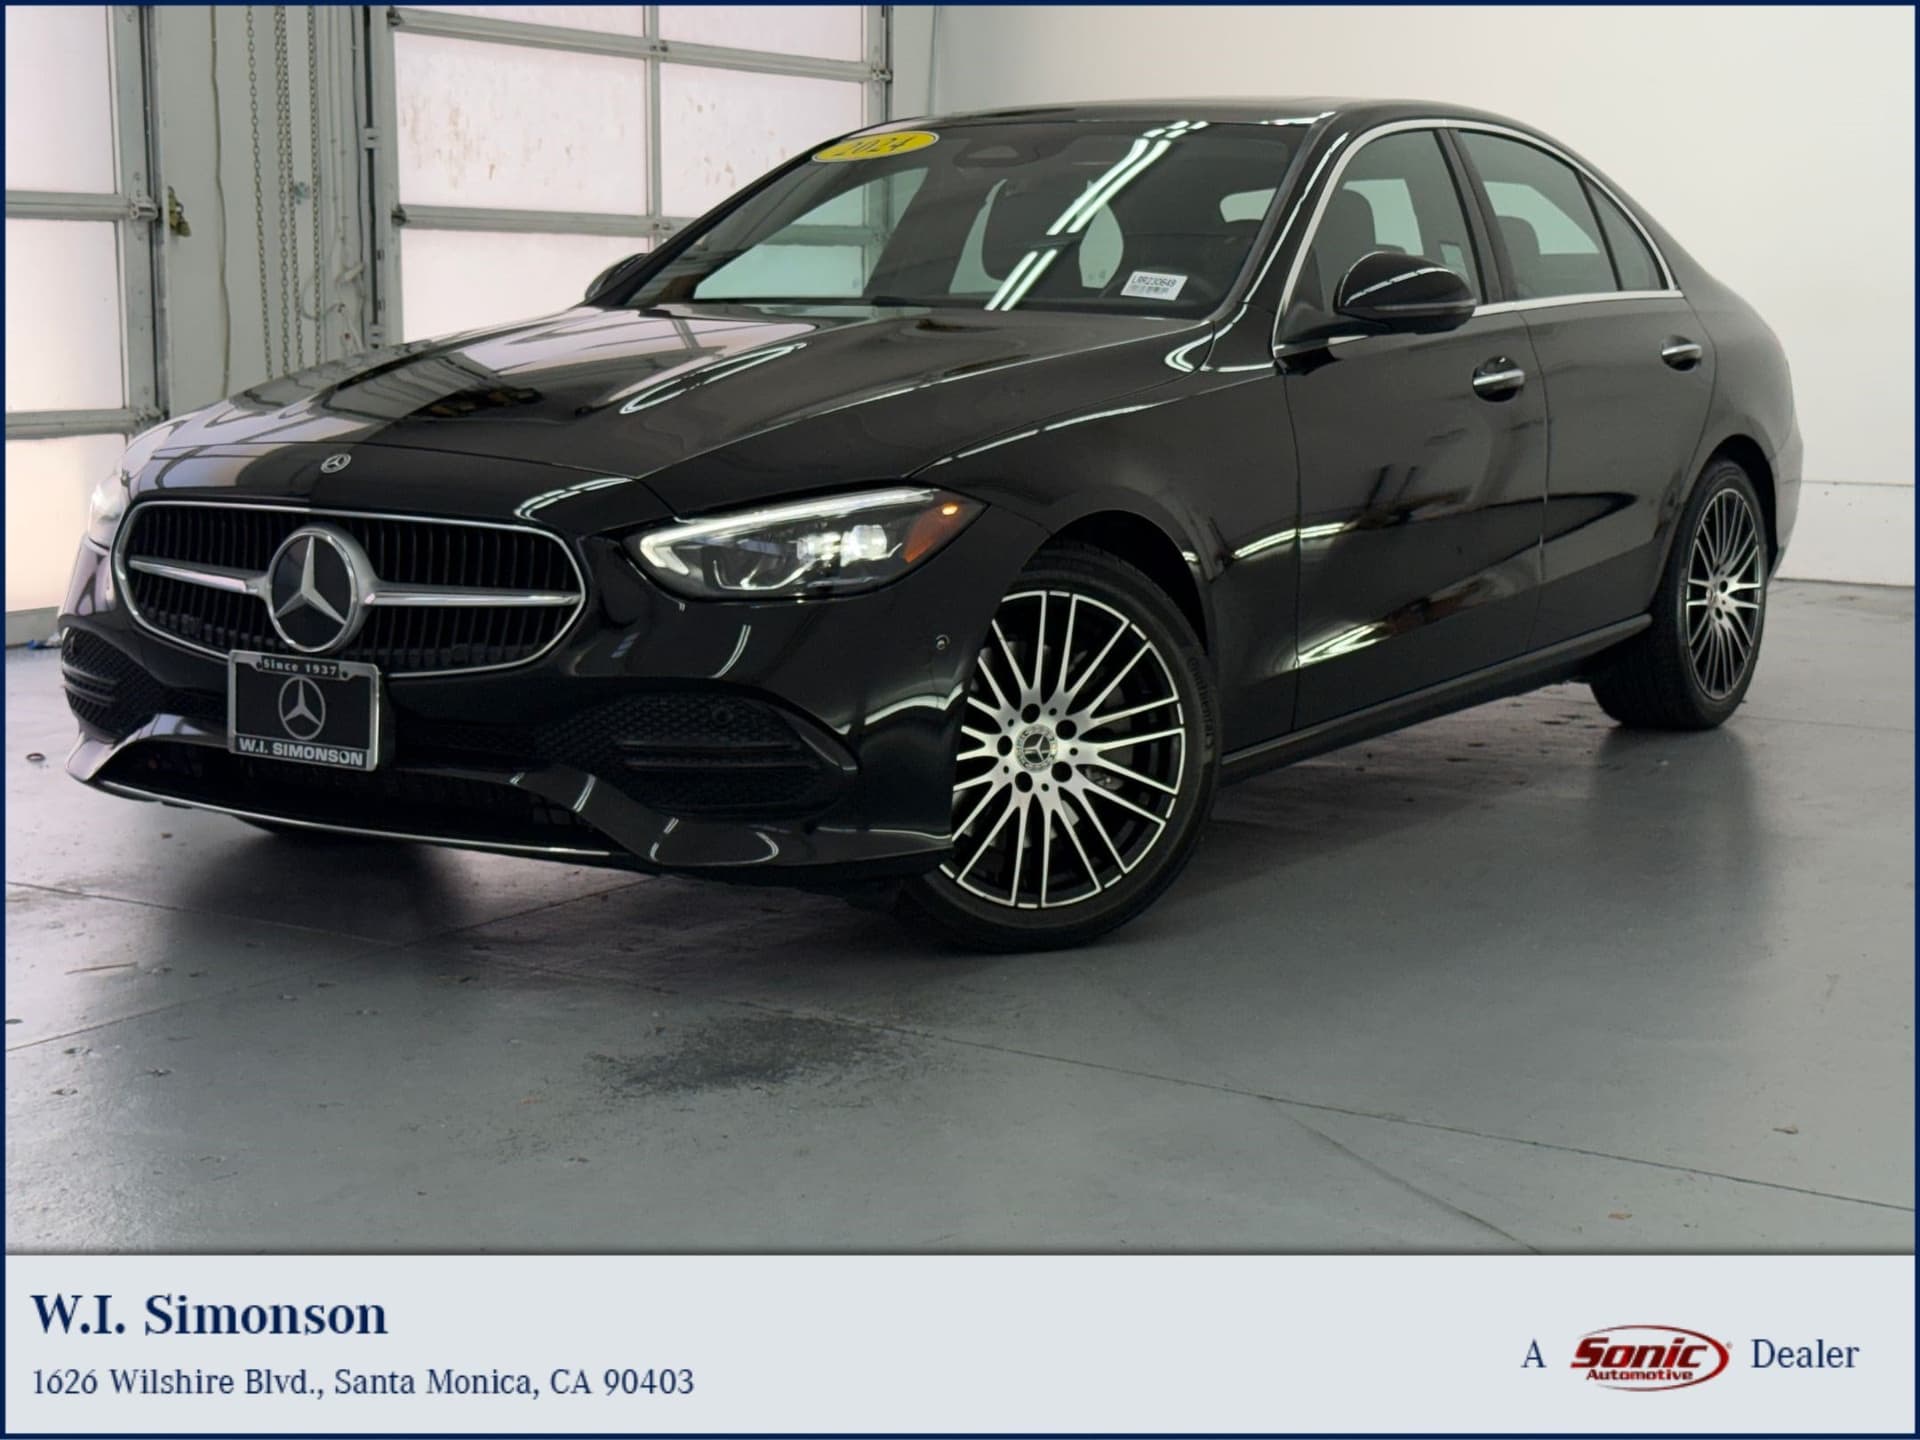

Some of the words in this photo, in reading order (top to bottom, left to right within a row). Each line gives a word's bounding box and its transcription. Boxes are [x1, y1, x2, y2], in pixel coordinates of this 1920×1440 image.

[263, 658, 299, 671] Since
[305, 662, 337, 675] 1937
[239, 737, 269, 752] W.I.
[272, 742, 364, 766] SIMONSON
